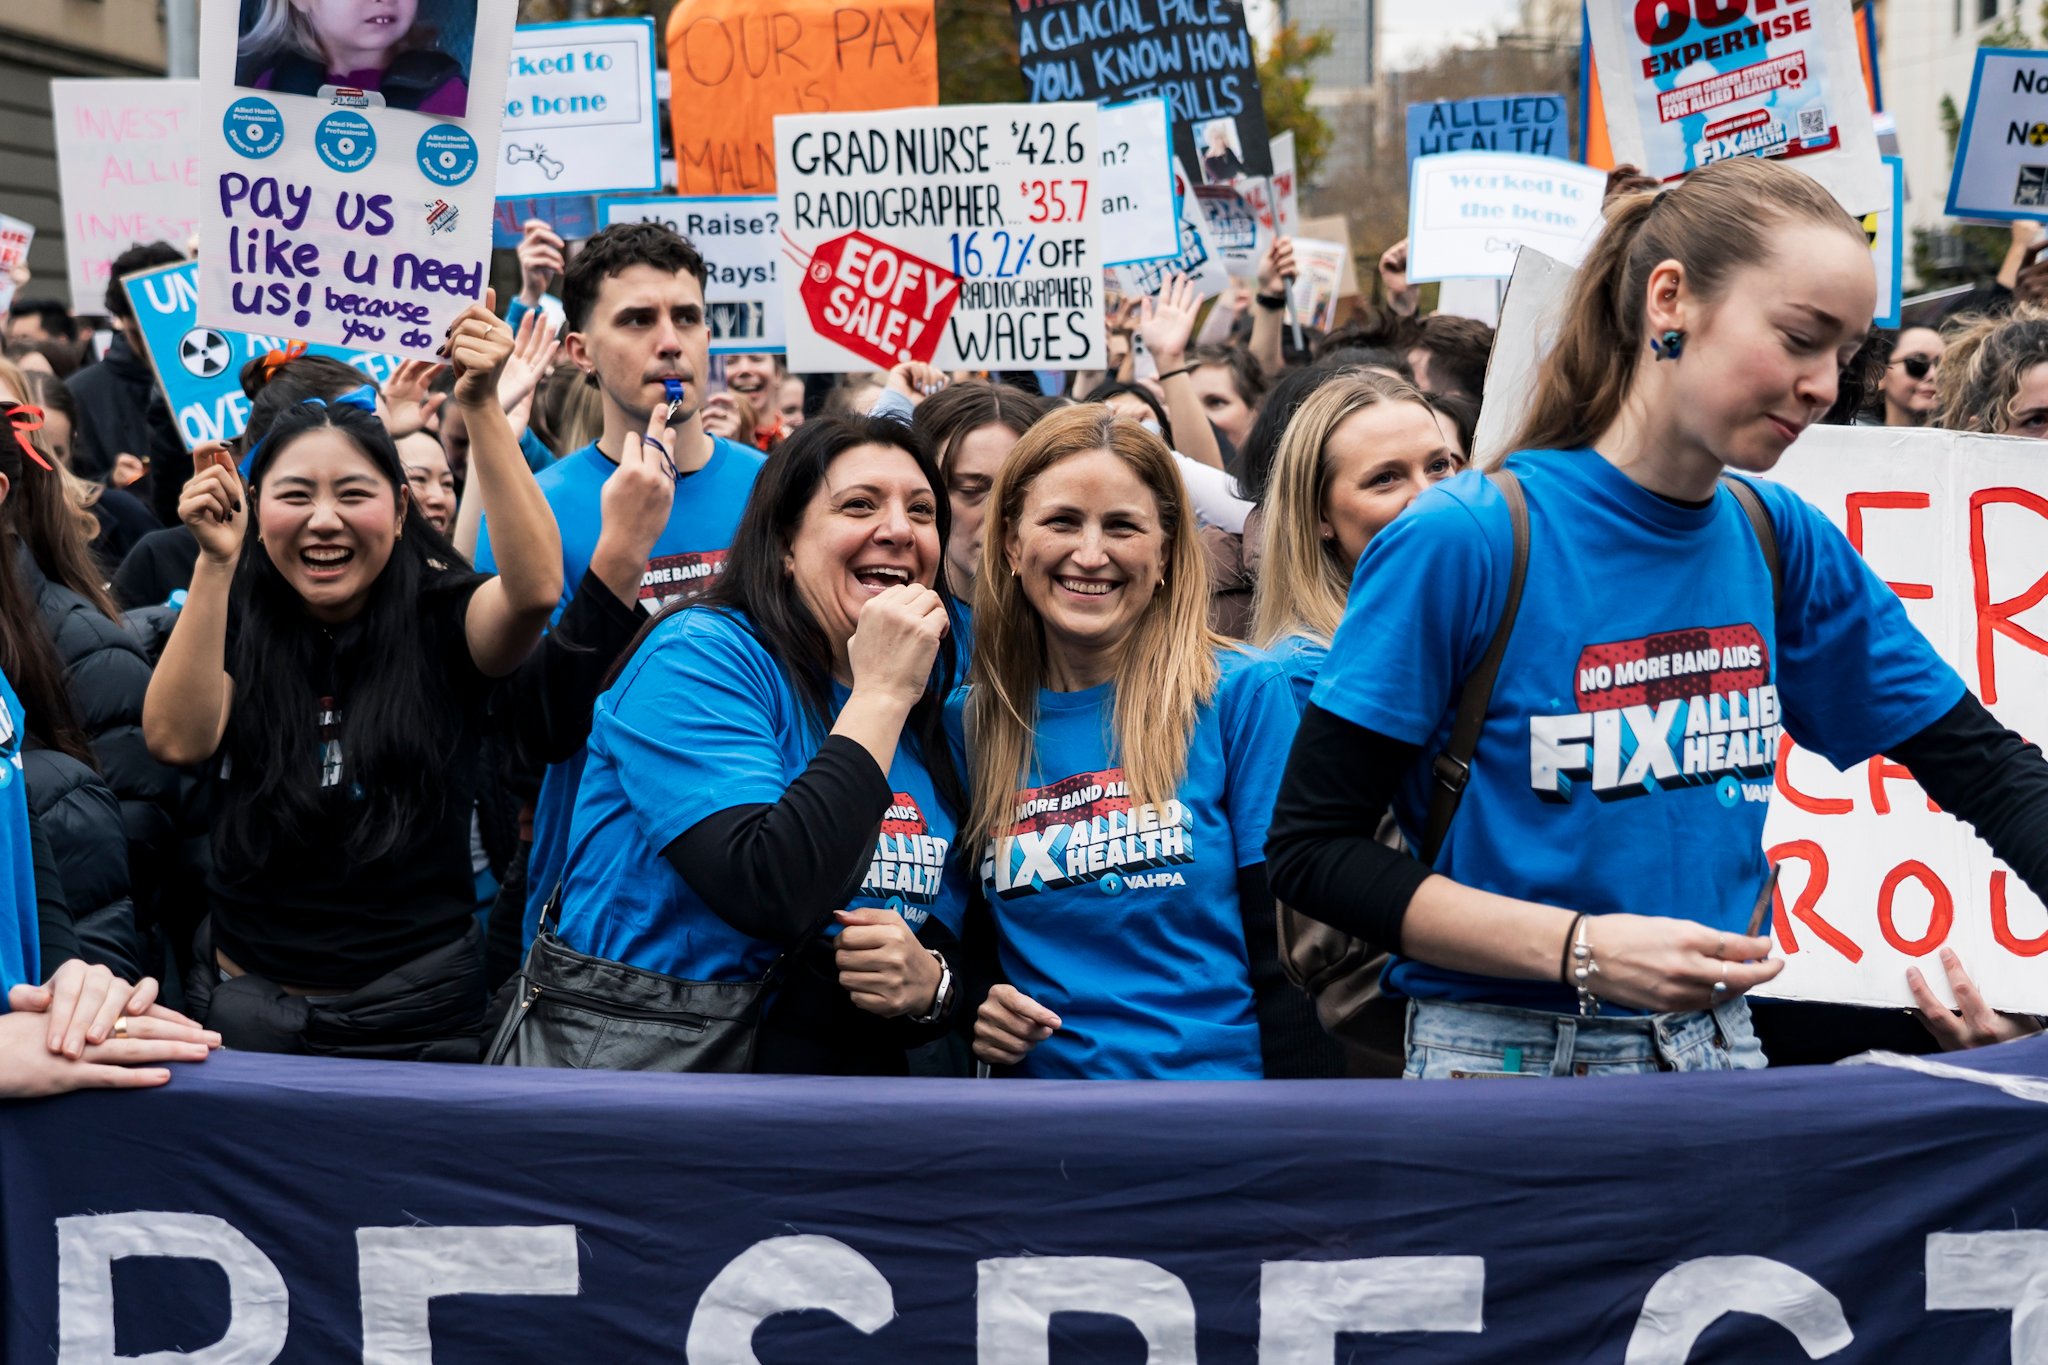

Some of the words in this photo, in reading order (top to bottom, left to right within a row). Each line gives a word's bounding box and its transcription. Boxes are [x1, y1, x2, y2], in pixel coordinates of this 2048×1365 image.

[684, 12, 811, 87] OUR
[833, 8, 931, 72] PAY
[1020, 20, 1037, 56] A
[1040, 0, 1154, 51] GLACIAL
[1157, 0, 1231, 28] PACE
[1641, 9, 1811, 80] EXPERTISE
[584, 51, 613, 72] to
[1022, 59, 1084, 102] YOU
[1092, 34, 1182, 89] KNOW
[1185, 28, 1249, 75] HOW
[532, 93, 607, 116] bone
[793, 80, 829, 112] IS
[1428, 96, 1560, 131] ALLIED
[1662, 102, 1690, 121] FOR
[1690, 87, 1733, 114] ALLIED
[1734, 72, 1782, 100] HEALTH
[792, 128, 888, 176] GRAD
[896, 124, 990, 176] NURSE
[1011, 122, 1084, 165] $42.6
[1693, 132, 1741, 166] FIX
[1740, 120, 1784, 142] ALLIED
[795, 184, 1004, 230] RADIOGRAPHER
[1020, 180, 1088, 224] $35.7
[1449, 174, 1554, 197] Worked
[1559, 182, 1583, 201] to
[687, 212, 779, 236] Raise?
[1460, 202, 1504, 218] the
[1512, 203, 1576, 226] bone
[229, 226, 320, 278] like
[343, 250, 378, 285] u
[393, 253, 482, 300] need
[706, 261, 777, 288] Rays!
[949, 231, 1035, 278] 16.2%
[1039, 238, 1086, 268] OFF
[834, 237, 956, 321] EOFY
[960, 276, 1092, 310] RADIOGRAPHER
[232, 281, 312, 327] us!
[325, 287, 431, 325] because
[823, 285, 925, 363] SALE!
[341, 319, 386, 345] you
[400, 329, 432, 348] do
[950, 311, 1090, 361] WAGES
[640, 568, 672, 587] ORE
[672, 562, 712, 582] BAND
[1580, 668, 1611, 692] NO
[1615, 656, 1671, 686] MORE
[1672, 649, 1721, 675] BAND
[1722, 644, 1761, 670] AIDS
[1530, 698, 1684, 792] FIX
[884, 805, 919, 821] AIDS
[1061, 783, 1102, 811] BAND
[1066, 799, 1182, 850] ALLIED
[1066, 826, 1184, 877] HEALTH
[861, 861, 944, 895] HEALTH
[1123, 872, 1186, 890] VAHPA
